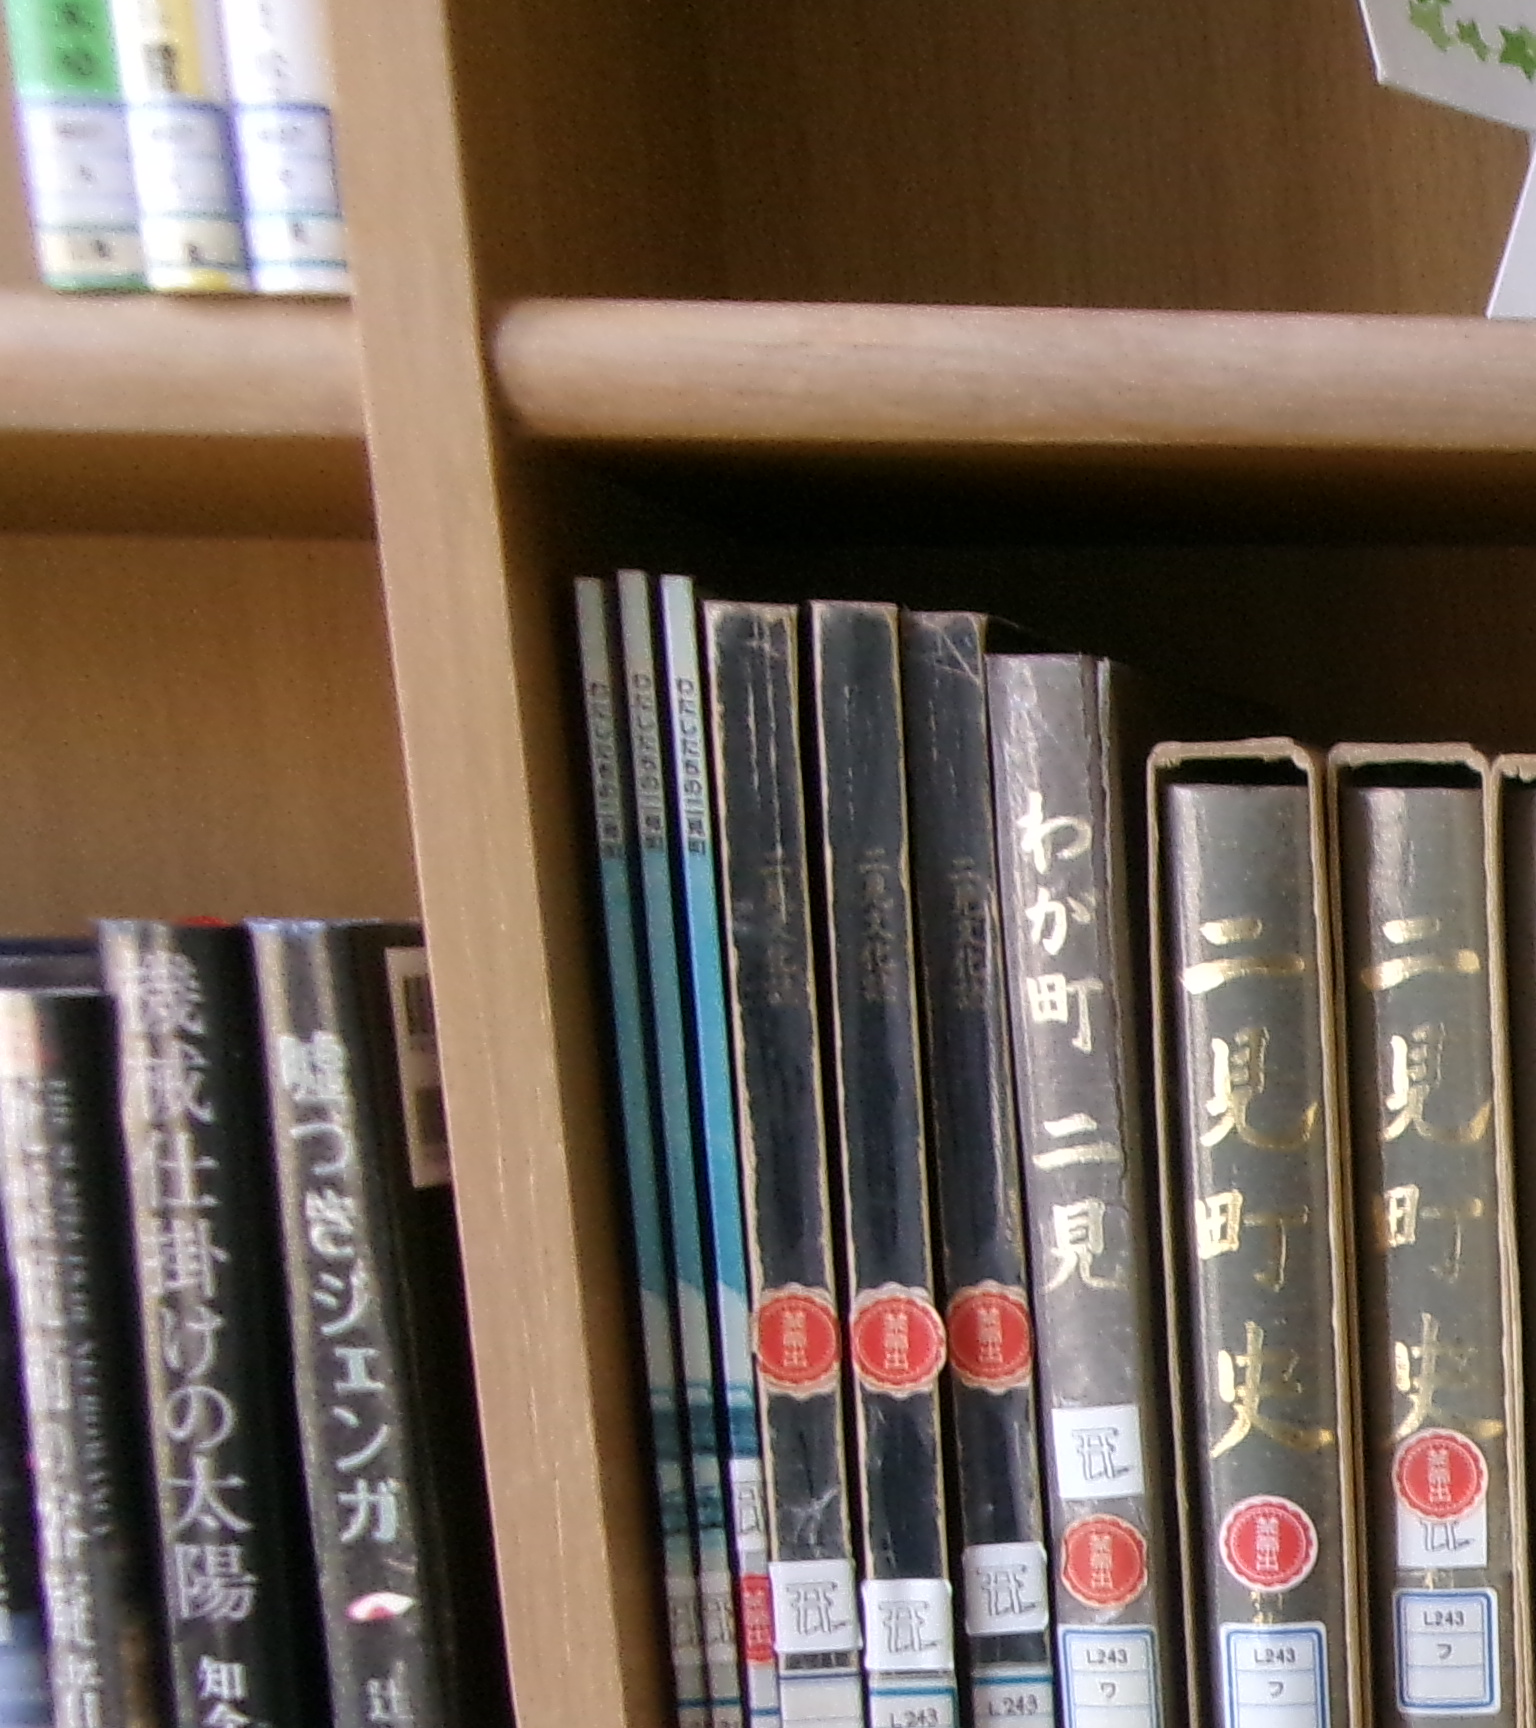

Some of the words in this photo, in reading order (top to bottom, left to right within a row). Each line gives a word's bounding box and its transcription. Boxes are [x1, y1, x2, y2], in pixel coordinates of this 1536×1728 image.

[1423, 1609, 1466, 1629] L243
[1085, 1647, 1129, 1667] L243
[1253, 1647, 1298, 1667] L243
